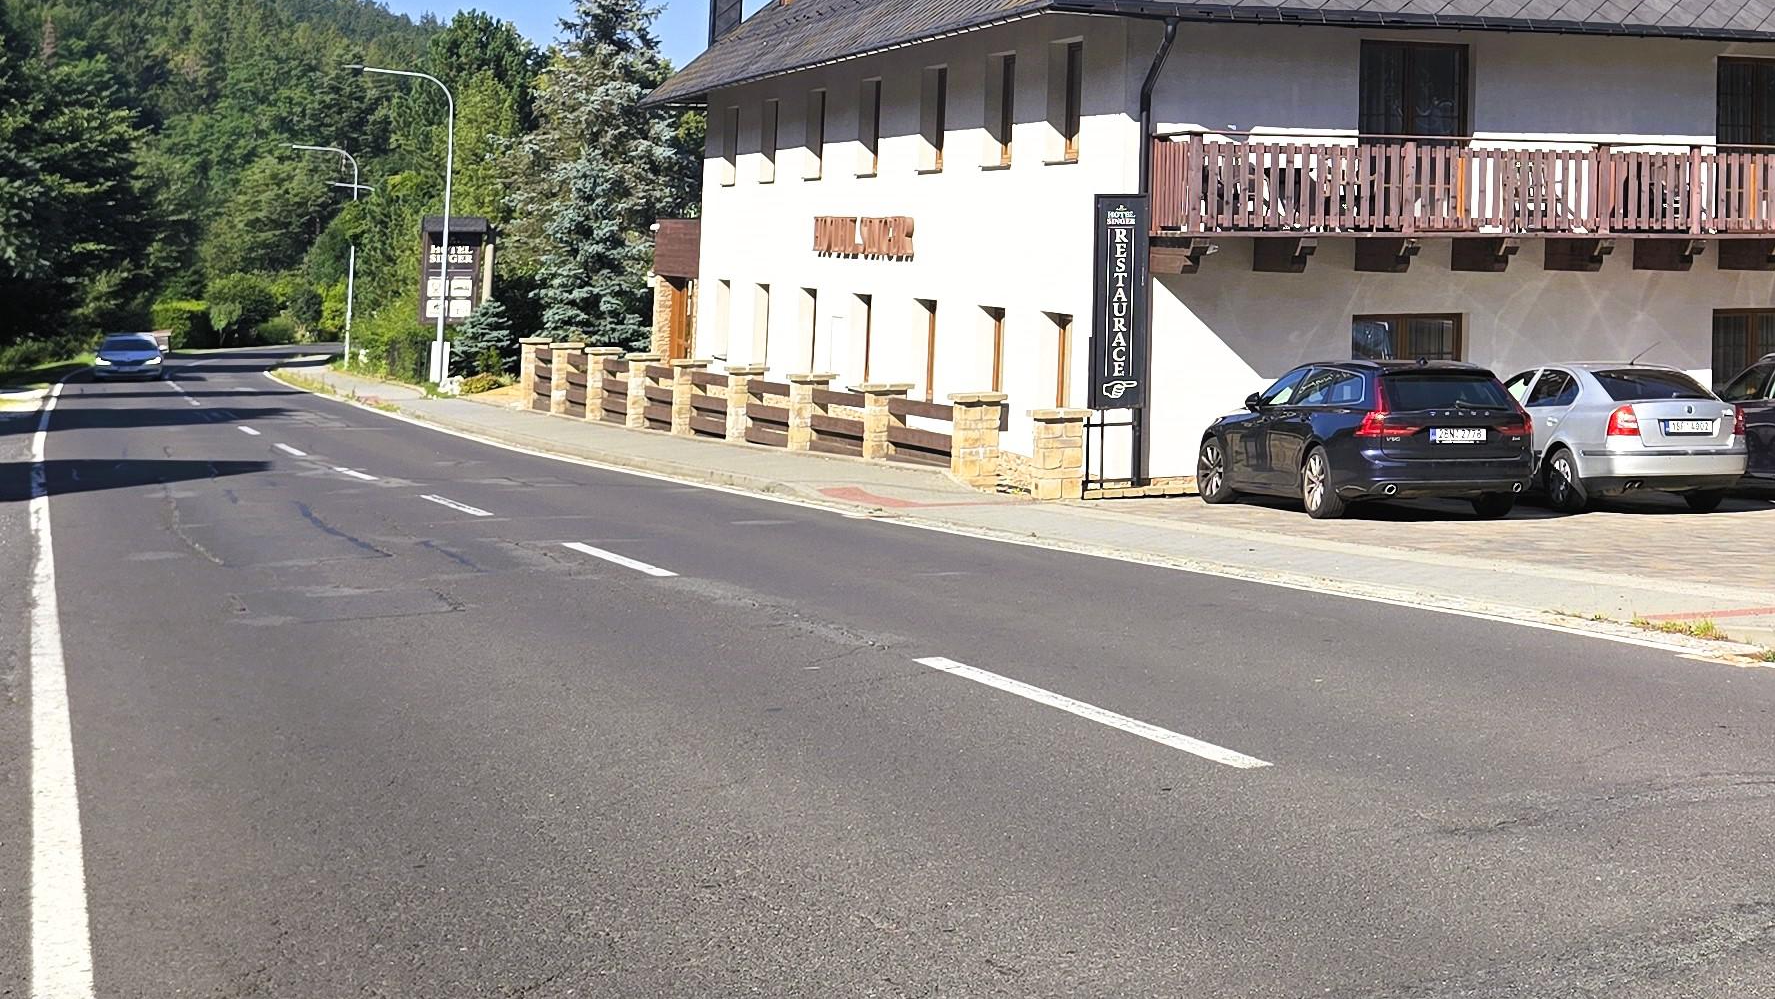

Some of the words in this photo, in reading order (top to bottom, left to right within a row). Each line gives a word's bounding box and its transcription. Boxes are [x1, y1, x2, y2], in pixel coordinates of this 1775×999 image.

[1107, 210, 1136, 219] HOTEL
[429, 254, 473, 264] SIGER
[1111, 228, 1129, 377] RESTAURACE
